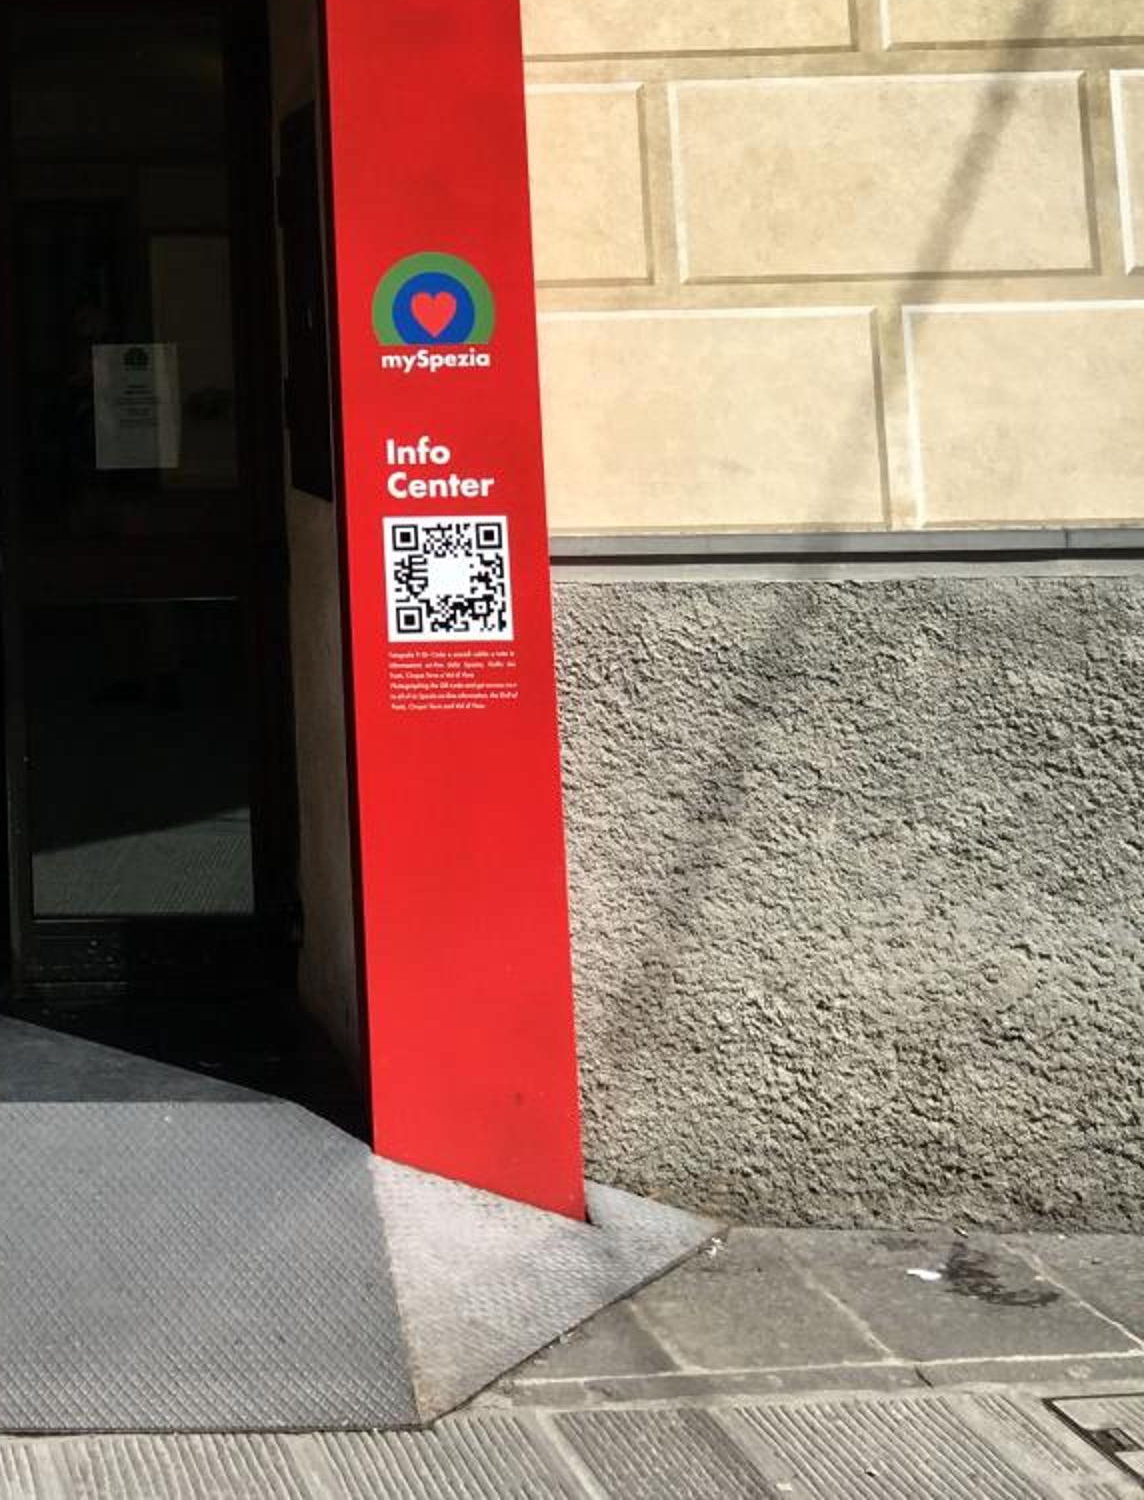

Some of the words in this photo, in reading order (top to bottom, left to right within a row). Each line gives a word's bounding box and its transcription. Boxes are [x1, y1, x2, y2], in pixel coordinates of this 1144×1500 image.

[382, 348, 490, 372] mySpezia
[387, 436, 450, 464] Info
[388, 472, 494, 498] Center
